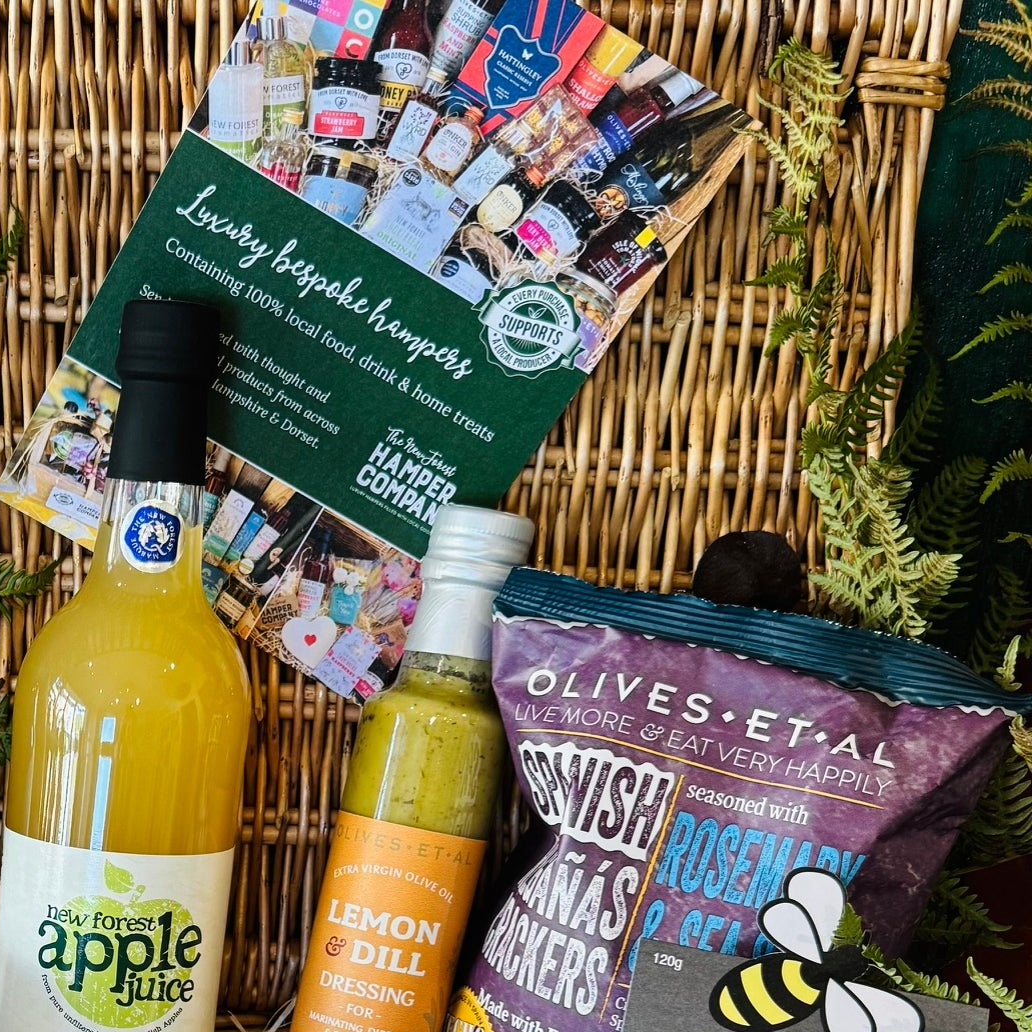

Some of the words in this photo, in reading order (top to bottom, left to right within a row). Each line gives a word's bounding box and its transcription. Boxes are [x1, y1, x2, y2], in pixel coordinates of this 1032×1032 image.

[498, 49, 543, 82] HATTINGLEY
[175, 184, 274, 269] Luxury
[271, 238, 369, 314] bespoke
[367, 296, 473, 381] hampers
[512, 290, 537, 303] EVERY
[537, 289, 569, 319] PURCHASE
[165, 237, 245, 298] Containing
[244, 285, 285, 317] 100%
[284, 308, 322, 339] local
[320, 329, 356, 364] food,
[358, 354, 398, 386] drink
[398, 377, 411, 394] &
[411, 383, 452, 417] home
[453, 410, 495, 443] treats
[498, 314, 563, 345] SUPPORTS
[222, 362, 274, 397] products
[270, 390, 303, 414] from
[303, 409, 340, 435] across
[368, 442, 457, 505] HAMPER
[514, 704, 556, 722] LIVE
[565, 706, 634, 733] MORE
[639, 722, 664, 742] &
[667, 730, 717, 758] EAT
[717, 740, 782, 774] VERY
[786, 759, 894, 798] HAPPILY
[686, 784, 767, 817] seasoned
[769, 801, 809, 826] with
[333, 864, 359, 879] EXTRA
[361, 864, 402, 878] VIRGIN
[404, 871, 439, 893] OLIVE
[438, 887, 454, 904] OIL
[46, 904, 89, 927] new
[92, 911, 157, 932] forest
[327, 898, 441, 947] LEMON
[37, 911, 202, 993] apple
[325, 936, 347, 957] &
[349, 939, 426, 978] DILL
[653, 953, 683, 971] 120g
[41, 974, 52, 994] from
[50, 995, 64, 1013] pure
[163, 1007, 183, 1028] Apples
[115, 972, 194, 1007] juice
[318, 970, 415, 1008] DRESSING
[478, 987, 510, 1023] Made
